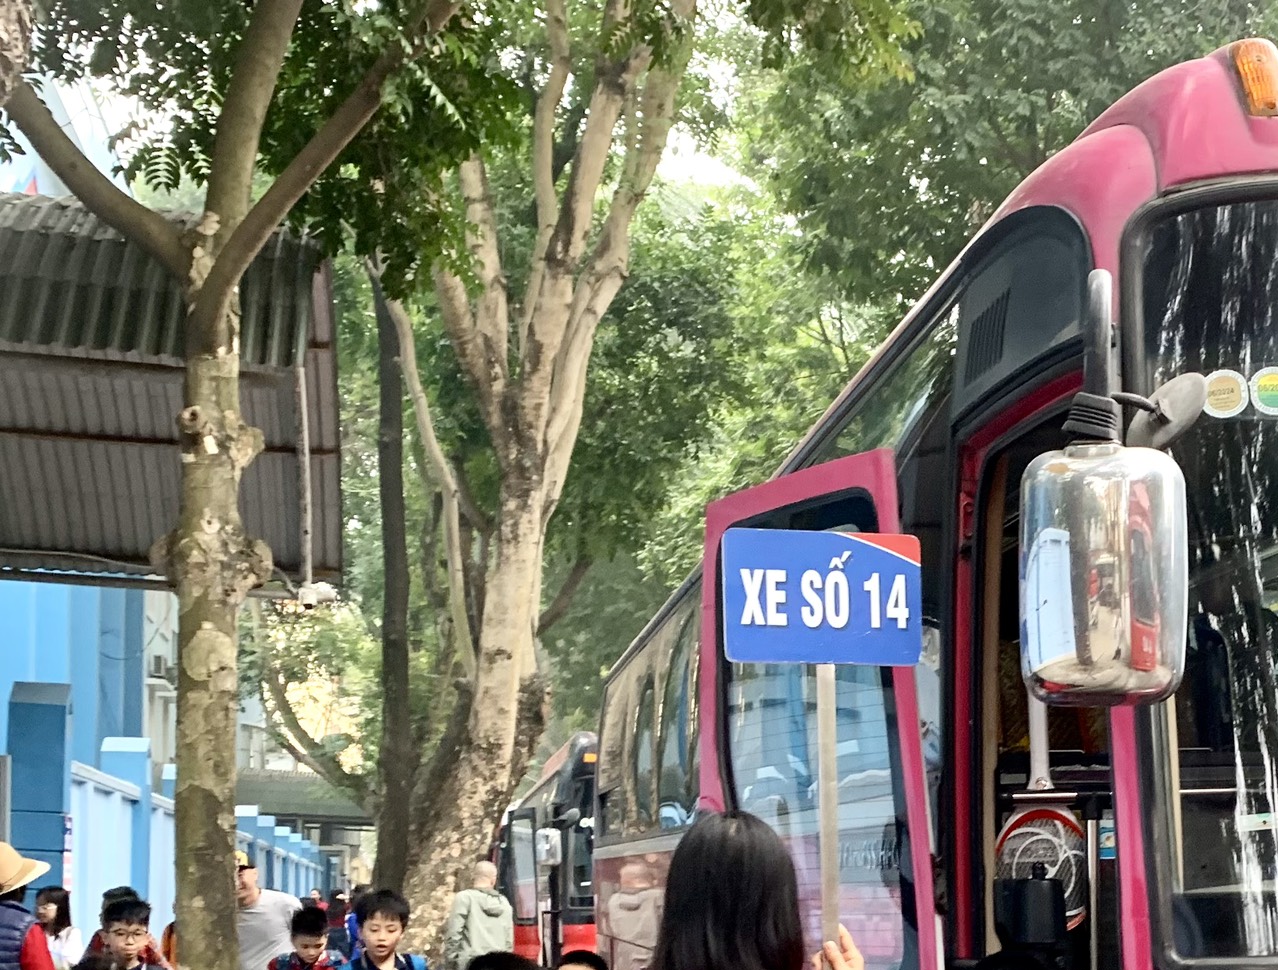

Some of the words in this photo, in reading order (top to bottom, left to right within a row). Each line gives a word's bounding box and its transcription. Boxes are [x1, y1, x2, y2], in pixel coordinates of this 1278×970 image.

[740, 568, 788, 626] XE
[801, 551, 852, 629] SỐ
[863, 572, 910, 629] 14
